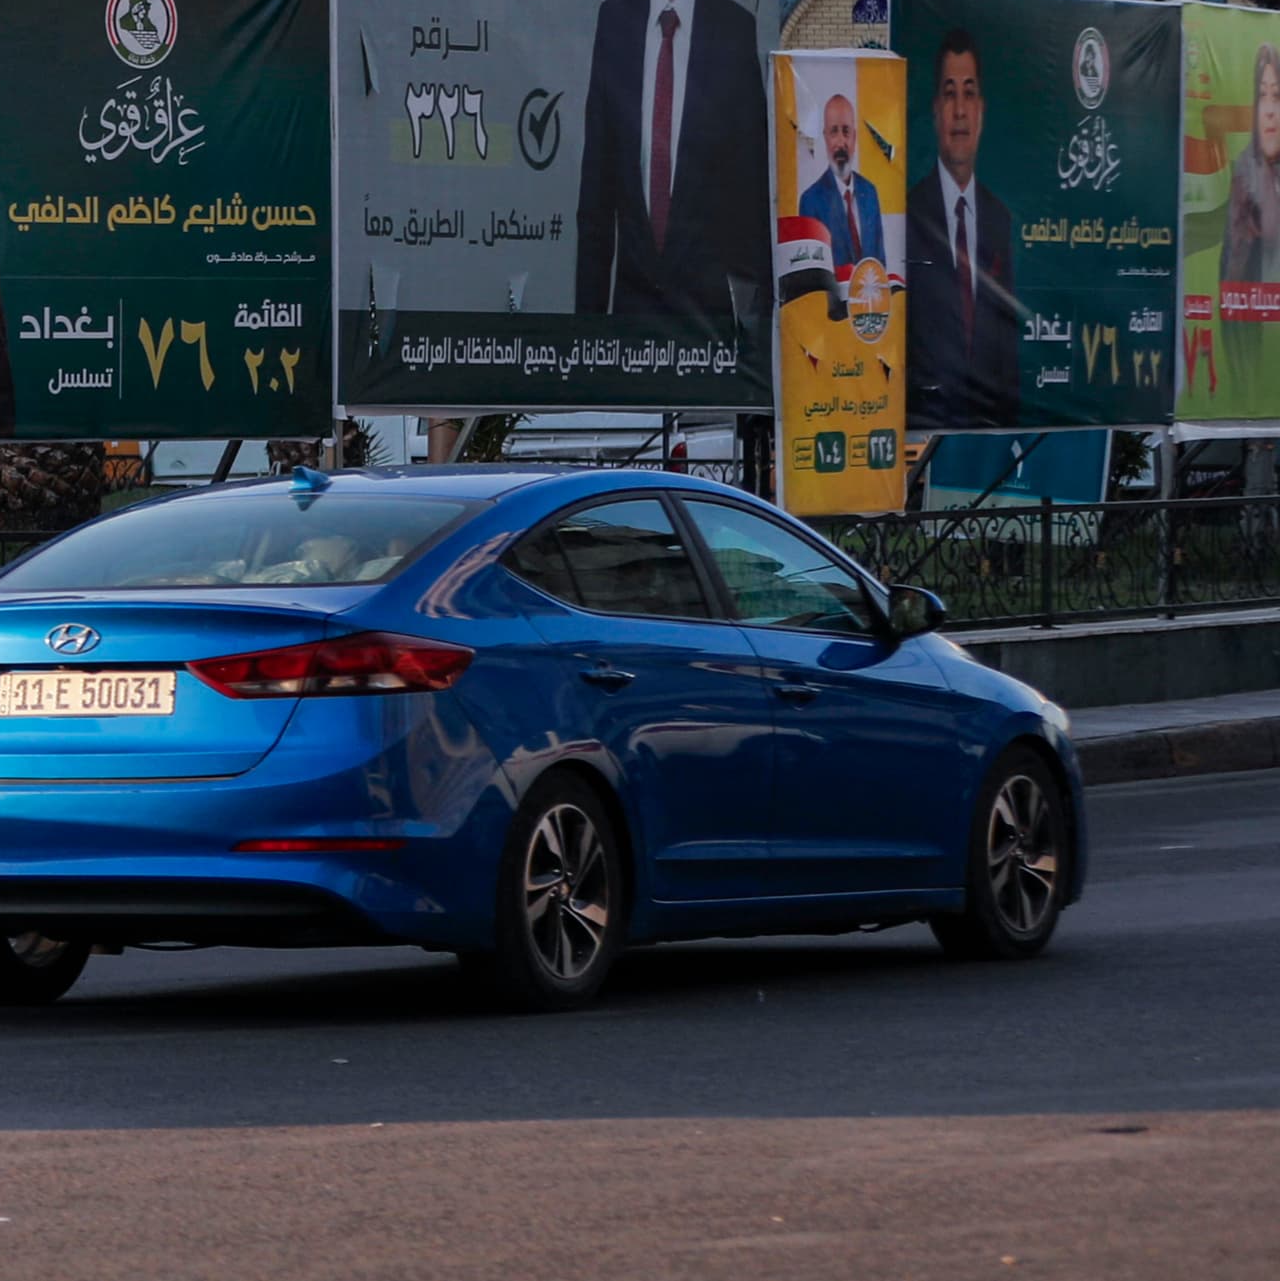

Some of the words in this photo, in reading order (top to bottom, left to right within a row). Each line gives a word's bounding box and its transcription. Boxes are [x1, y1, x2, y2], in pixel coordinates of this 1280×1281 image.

[410, 17, 488, 60] الرقم
[405, 82, 488, 160] ٣٢٦
[107, 194, 176, 232] كاظم
[255, 199, 317, 231] حسن
[19, 306, 114, 348] بغداد
[234, 298, 302, 330] القائمة
[1023, 312, 1073, 348] بغداد
[138, 317, 216, 392] ٧٦
[401, 336, 452, 372] العراقية
[454, 336, 521, 365] المحافظات
[523, 344, 557, 376] جميع
[560, 339, 579, 380] في
[621, 340, 675, 374] العراقيين
[677, 340, 713, 377] لجميع
[47, 369, 114, 395] تسلسل
[244, 345, 301, 395] ٢٠٢
[81, 677, 161, 710] 50031
